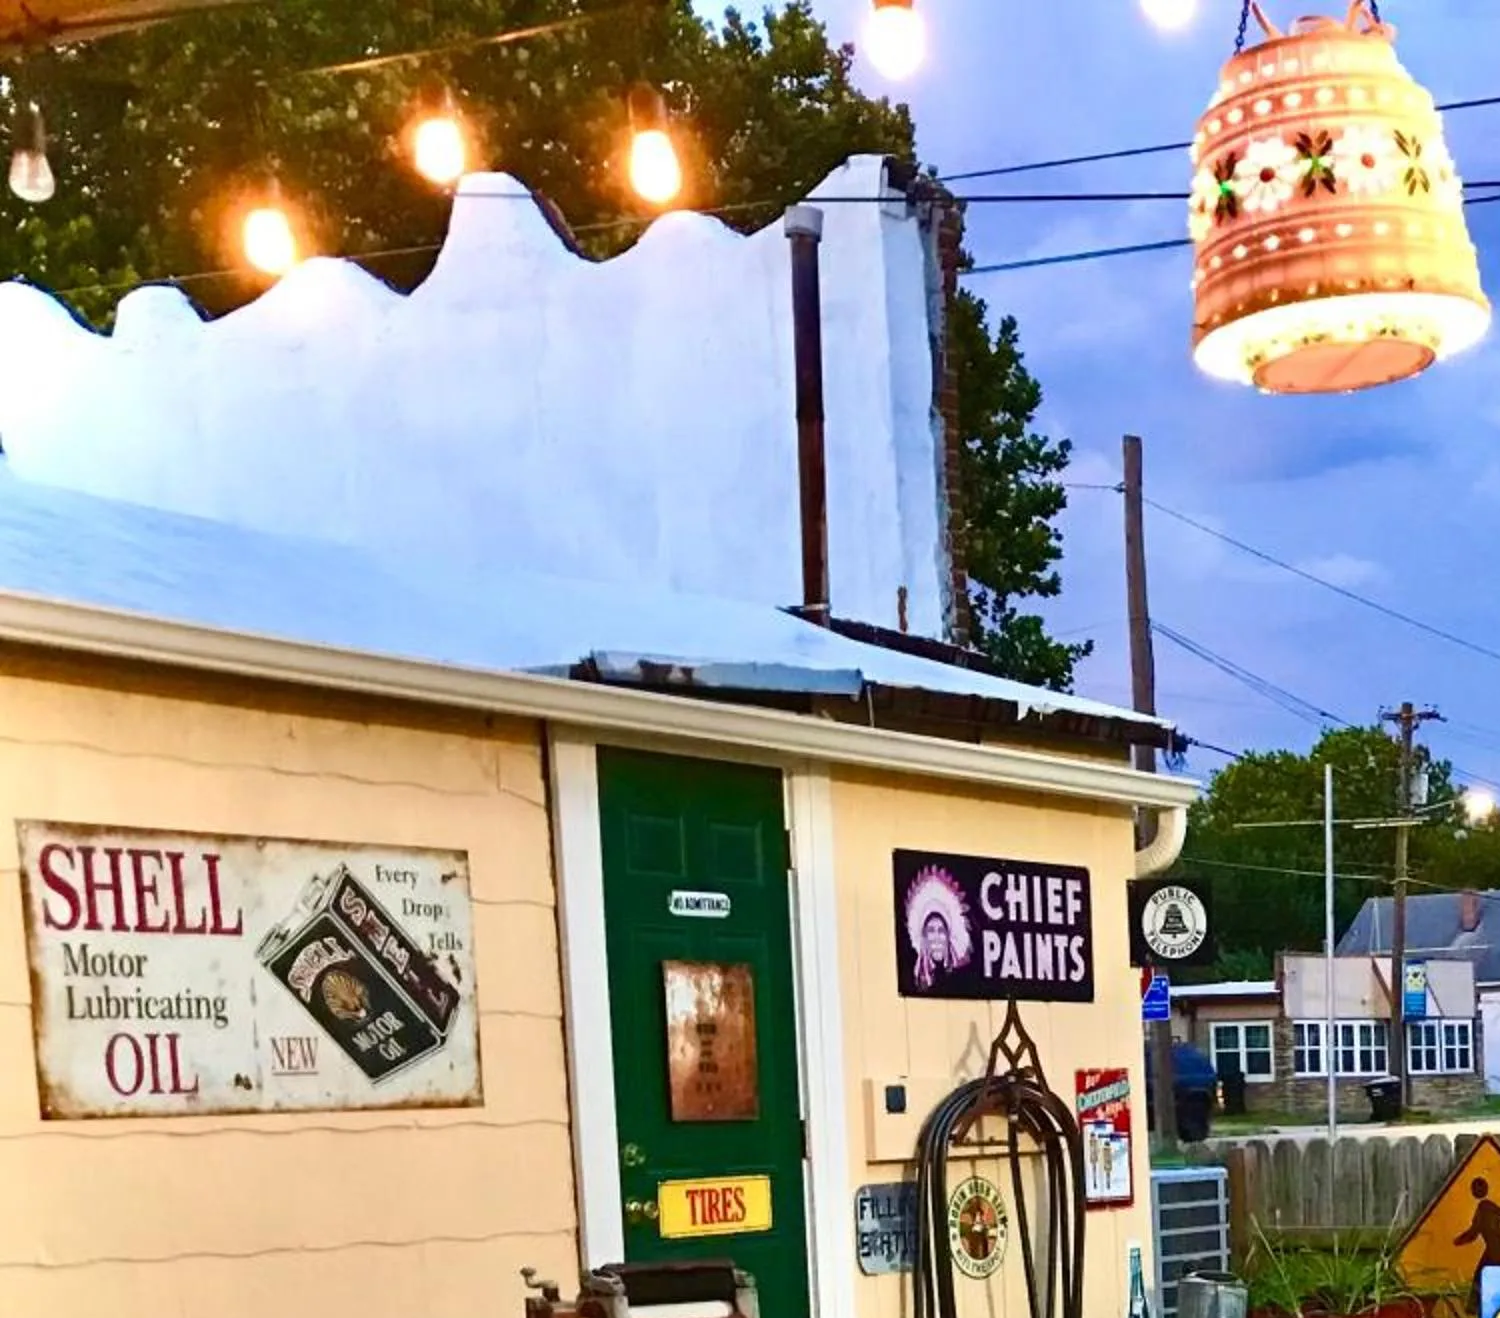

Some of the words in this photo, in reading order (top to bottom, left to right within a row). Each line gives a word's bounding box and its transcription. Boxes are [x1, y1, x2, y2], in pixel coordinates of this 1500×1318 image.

[39, 843, 243, 937] SHELL
[375, 864, 418, 890] Every
[980, 870, 1083, 924] CHIEF
[1151, 888, 1195, 905] PUBLIC
[402, 898, 443, 921] Drop
[63, 943, 149, 979] Motor
[982, 931, 1086, 984] PAINTS
[1148, 929, 1203, 956] TELEPHONE
[66, 985, 229, 1028] Lubricating
[352, 1011, 406, 1053] MOTOR
[105, 1032, 199, 1097] OIL
[270, 1037, 318, 1071] NEW
[686, 1187, 747, 1227] TIRES
